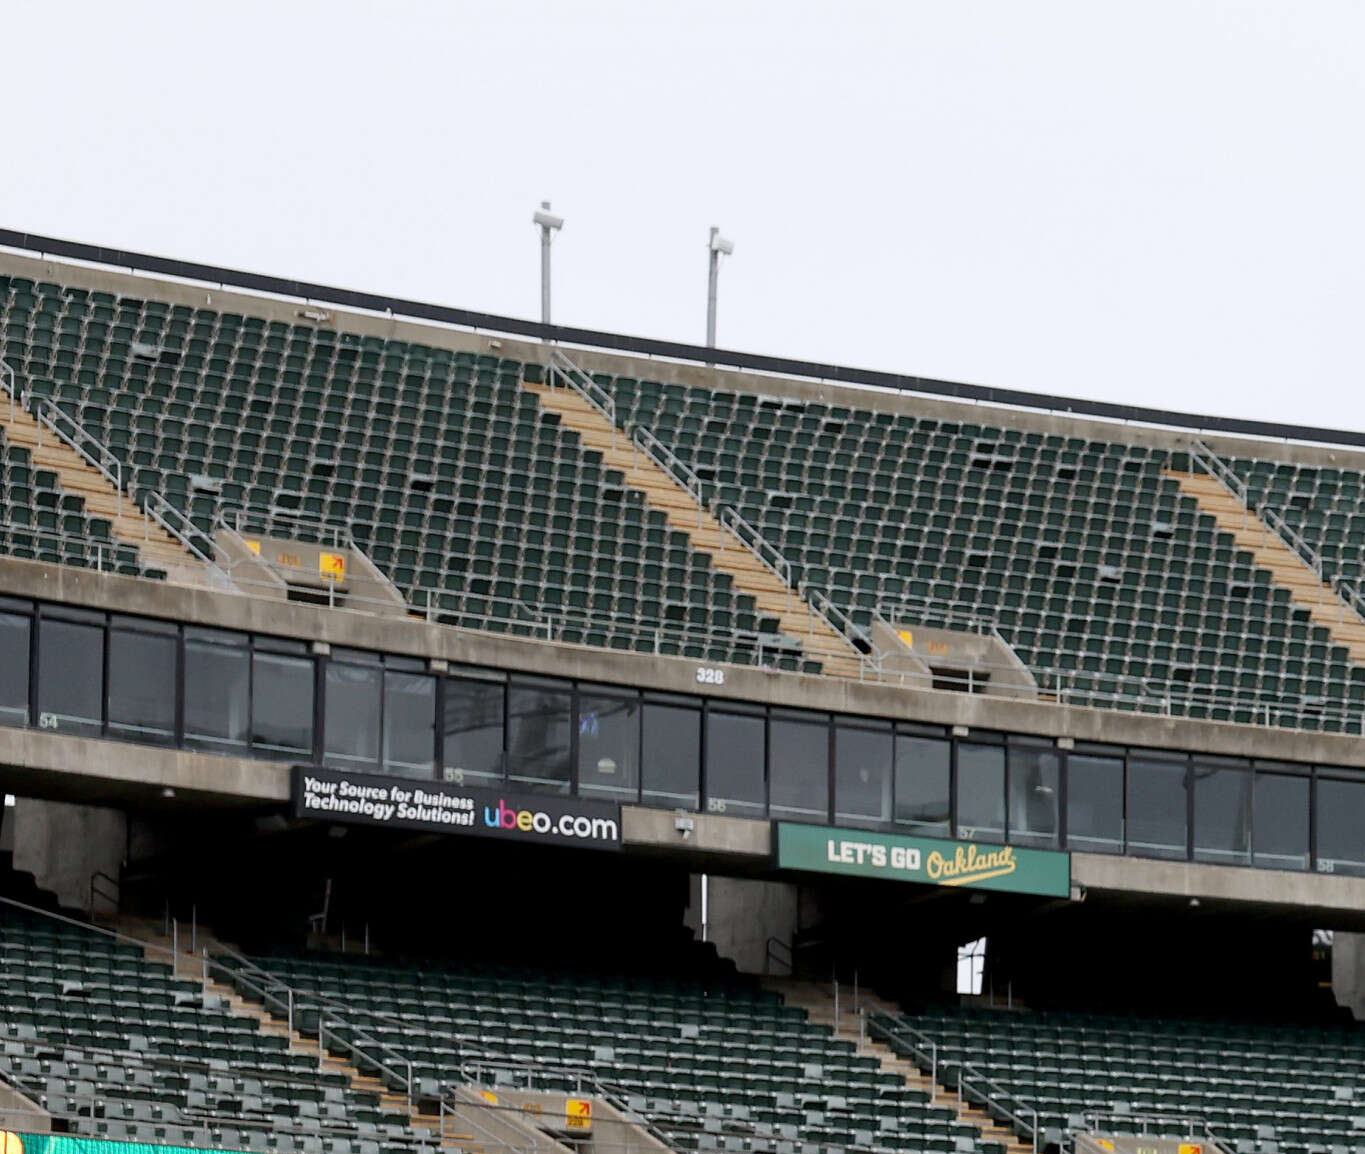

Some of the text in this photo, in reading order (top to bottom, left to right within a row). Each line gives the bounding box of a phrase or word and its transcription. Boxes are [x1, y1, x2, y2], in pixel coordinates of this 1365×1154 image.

[696, 667, 725, 684] 328
[304, 776, 474, 811] Your Source for Business
[304, 792, 475, 826] Technology Solutions!
[484, 799, 617, 841] ubeo.com
[827, 839, 1017, 887] LET'S GO Oakland
